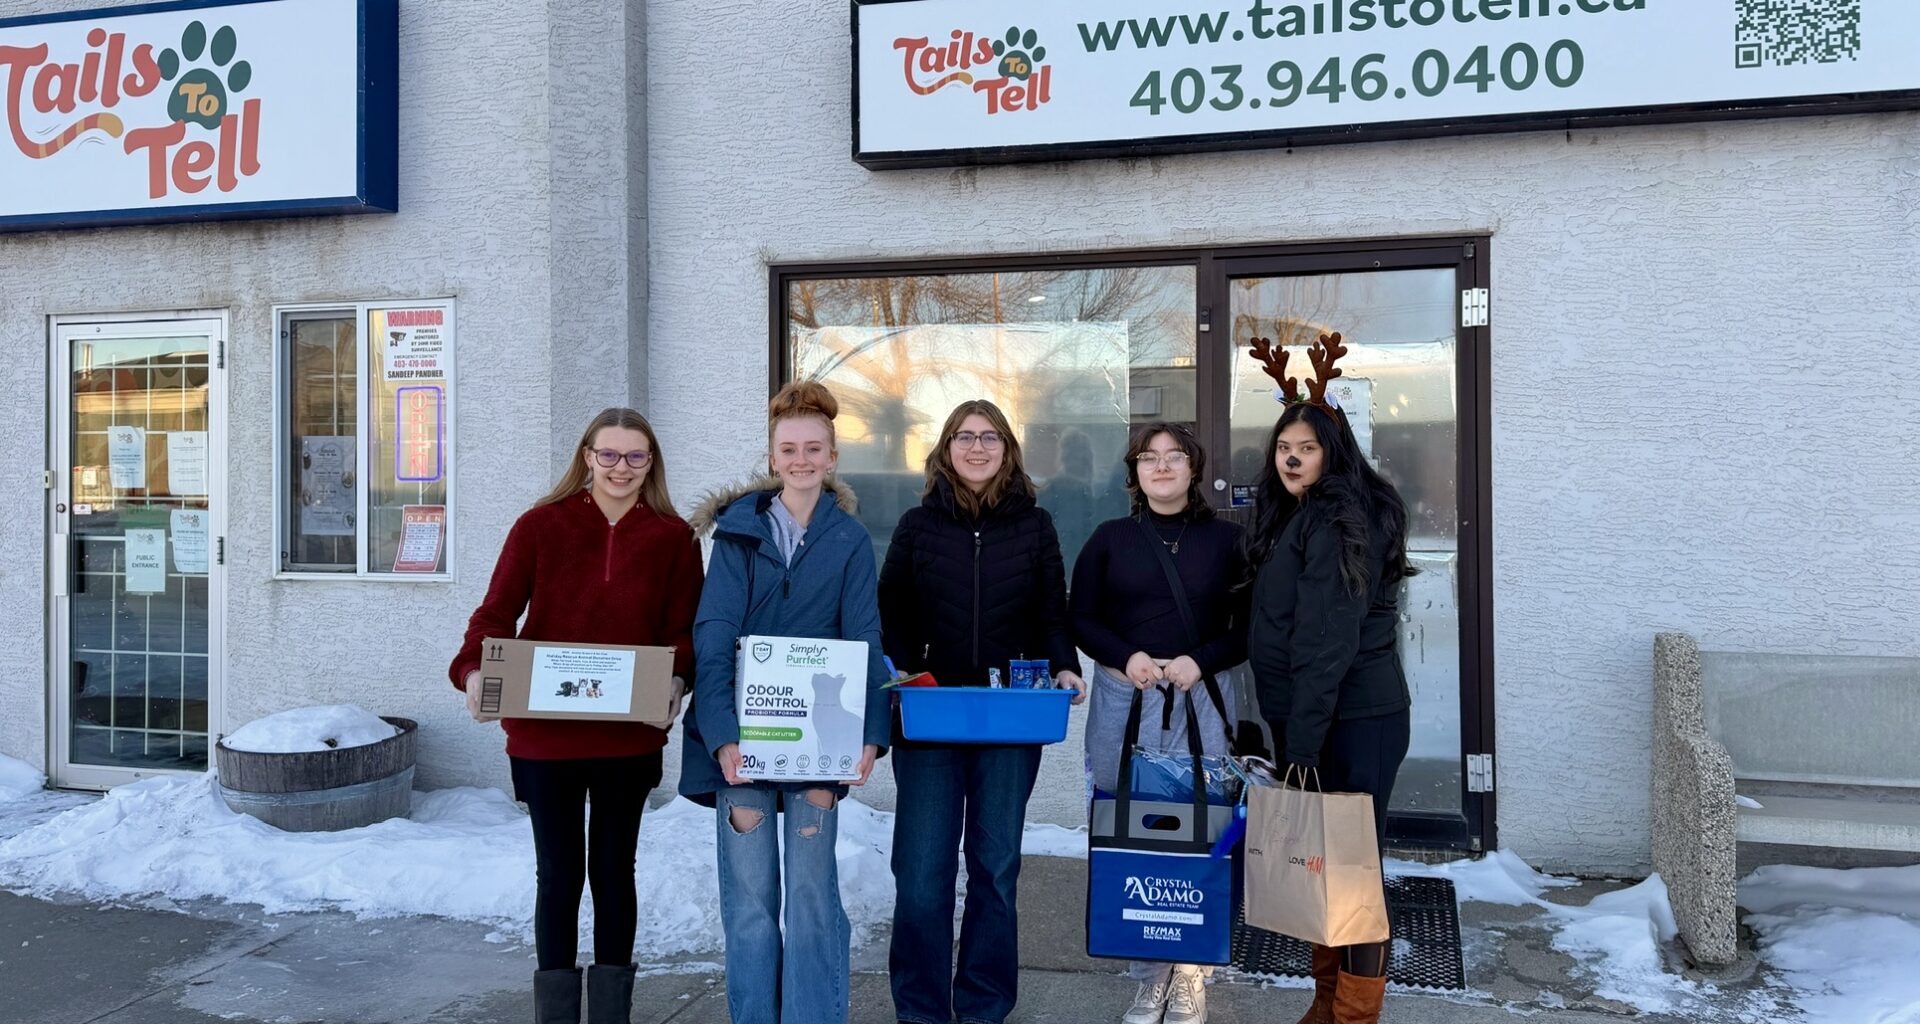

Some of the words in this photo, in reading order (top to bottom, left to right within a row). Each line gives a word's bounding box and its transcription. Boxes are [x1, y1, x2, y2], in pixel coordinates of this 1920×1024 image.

[893, 29, 996, 88] Tails
[1004, 56, 1027, 75] To
[0, 28, 161, 140] Tails
[1129, 38, 1584, 116] 403.946.0400
[973, 64, 1051, 115] Tell
[178, 82, 219, 117] To
[123, 98, 261, 199] Tell
[387, 310, 443, 326] WARNING
[388, 370, 414, 378] SANDEEP
[790, 643, 827, 657] Simply
[786, 655, 826, 665] Purrfect
[747, 684, 793, 696] ODOUR
[746, 696, 807, 708] CONTROL
[1288, 856, 1306, 866] LOVE
[1145, 876, 1195, 889] CRYSTAL
[1124, 876, 1204, 906] ADAMO
[1134, 911, 1193, 922] CrystalAdamo.com
[1143, 925, 1181, 937] RE/MAX
